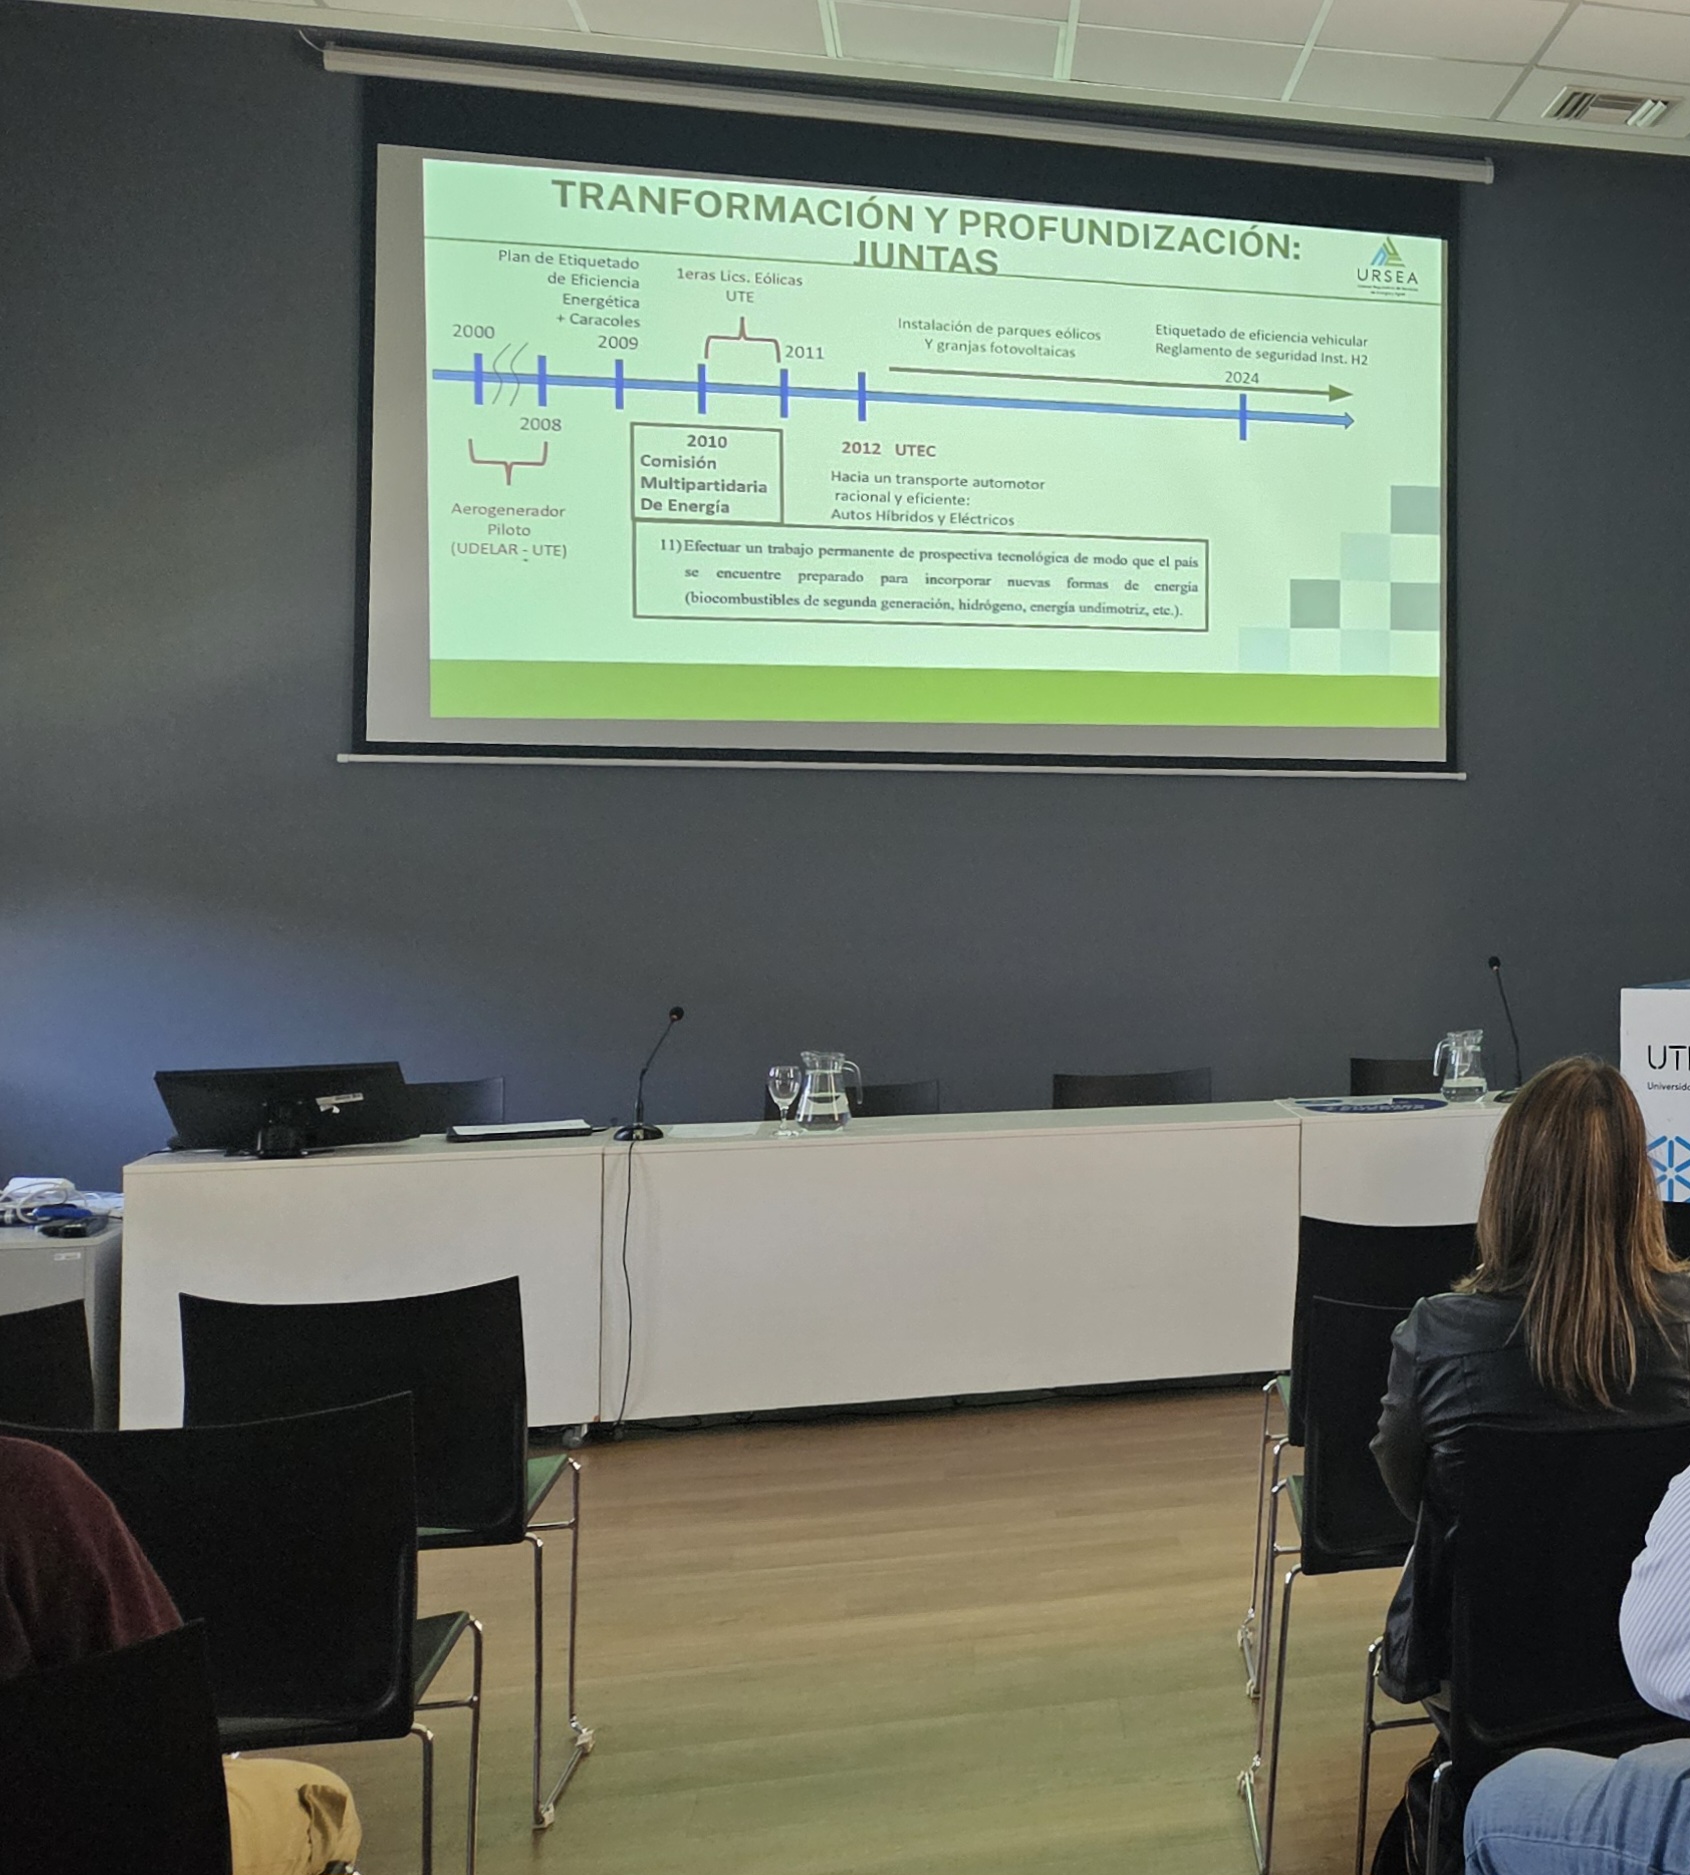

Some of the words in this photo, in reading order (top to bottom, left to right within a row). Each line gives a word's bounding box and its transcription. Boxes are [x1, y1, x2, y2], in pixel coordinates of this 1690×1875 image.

[551, 179, 914, 232] TRANFORMACIÓN
[926, 207, 949, 234] Y
[960, 210, 1302, 260] PROFUNDIZACIÓN:
[498, 250, 528, 264] Plan
[534, 252, 553, 266] de
[559, 253, 640, 272] Etiquetado
[854, 241, 998, 276] JUNTAS
[548, 270, 565, 286] de
[571, 272, 640, 289] Eficiencia
[678, 268, 715, 283] 1eras
[720, 269, 750, 285] Lics.
[755, 270, 803, 287] Eólicas
[1357, 268, 1418, 284] URSEA
[563, 292, 640, 311] Energética
[726, 291, 754, 303] UTE
[557, 315, 565, 323] +
[570, 311, 640, 329] Caracoles
[452, 323, 495, 340] 2000
[898, 318, 973, 334] Instalación
[977, 321, 993, 335] de
[997, 323, 1051, 340] parques
[1056, 326, 1101, 341] eólicos
[1156, 325, 1226, 342] Etiquetado
[1230, 329, 1245, 341] de
[1250, 330, 1308, 345] eficiencia
[1312, 333, 1368, 348] vehicular
[598, 335, 638, 350] 2009
[925, 339, 933, 350] Y
[936, 340, 986, 357] granjas
[990, 341, 1076, 359] fotovoltaicas
[785, 346, 824, 360] 2011
[1156, 343, 1231, 360] Reglamento
[1236, 345, 1251, 358] de
[1256, 348, 1318, 364] seguridad
[1322, 351, 1347, 364] Inst.
[1352, 353, 1368, 365] H2
[1225, 371, 1259, 385] 2024
[520, 417, 562, 432] 2008
[687, 435, 727, 448] 2010
[842, 442, 881, 455] 2012
[896, 444, 936, 457] UTEC
[641, 454, 716, 470] Comisión
[641, 477, 767, 494] Multipartidaria
[831, 471, 870, 484] Hacia
[875, 474, 891, 484] un
[896, 474, 968, 489] transporte
[973, 477, 1045, 490] automotor
[836, 491, 891, 503] racional
[895, 494, 902, 506] y
[907, 492, 970, 506] eficiente:
[452, 503, 565, 519] Aerogenerador
[641, 499, 662, 512] De
[668, 499, 729, 516] Energía
[831, 509, 871, 522] Autos
[877, 509, 933, 524] Híbridos
[938, 515, 945, 527] y
[950, 512, 1014, 526] Eléctricos
[488, 523, 530, 536] Piloto
[452, 542, 518, 557] (UDELAR
[532, 543, 567, 559] UTE)
[747, 545, 763, 554] un
[768, 543, 813, 558] trabajo
[819, 546, 894, 560] permanente
[900, 547, 914, 558] de
[920, 548, 992, 563] prospectiva
[998, 549, 1069, 566] tecnológica
[1074, 552, 1088, 564] de
[1093, 553, 1127, 565] modo
[1133, 557, 1155, 569] que
[1160, 556, 1169, 567] el
[1175, 557, 1199, 571] país
[685, 568, 698, 577] se
[717, 570, 781, 580] encuentre
[798, 571, 864, 585] preparado
[881, 575, 908, 587] para
[925, 576, 991, 589] incorporar
[1008, 579, 1050, 588] nuevas
[1067, 578, 1109, 590] formas
[1125, 580, 1138, 591] de
[1155, 581, 1199, 595] energía
[685, 592, 799, 606] (biocombustibles
[804, 595, 820, 606] de
[824, 597, 876, 609] segunda
[881, 598, 954, 613] generación,
[959, 599, 1026, 615] hidrógeno,
[1031, 602, 1075, 616] energía
[1080, 602, 1149, 618] undimotriz,
